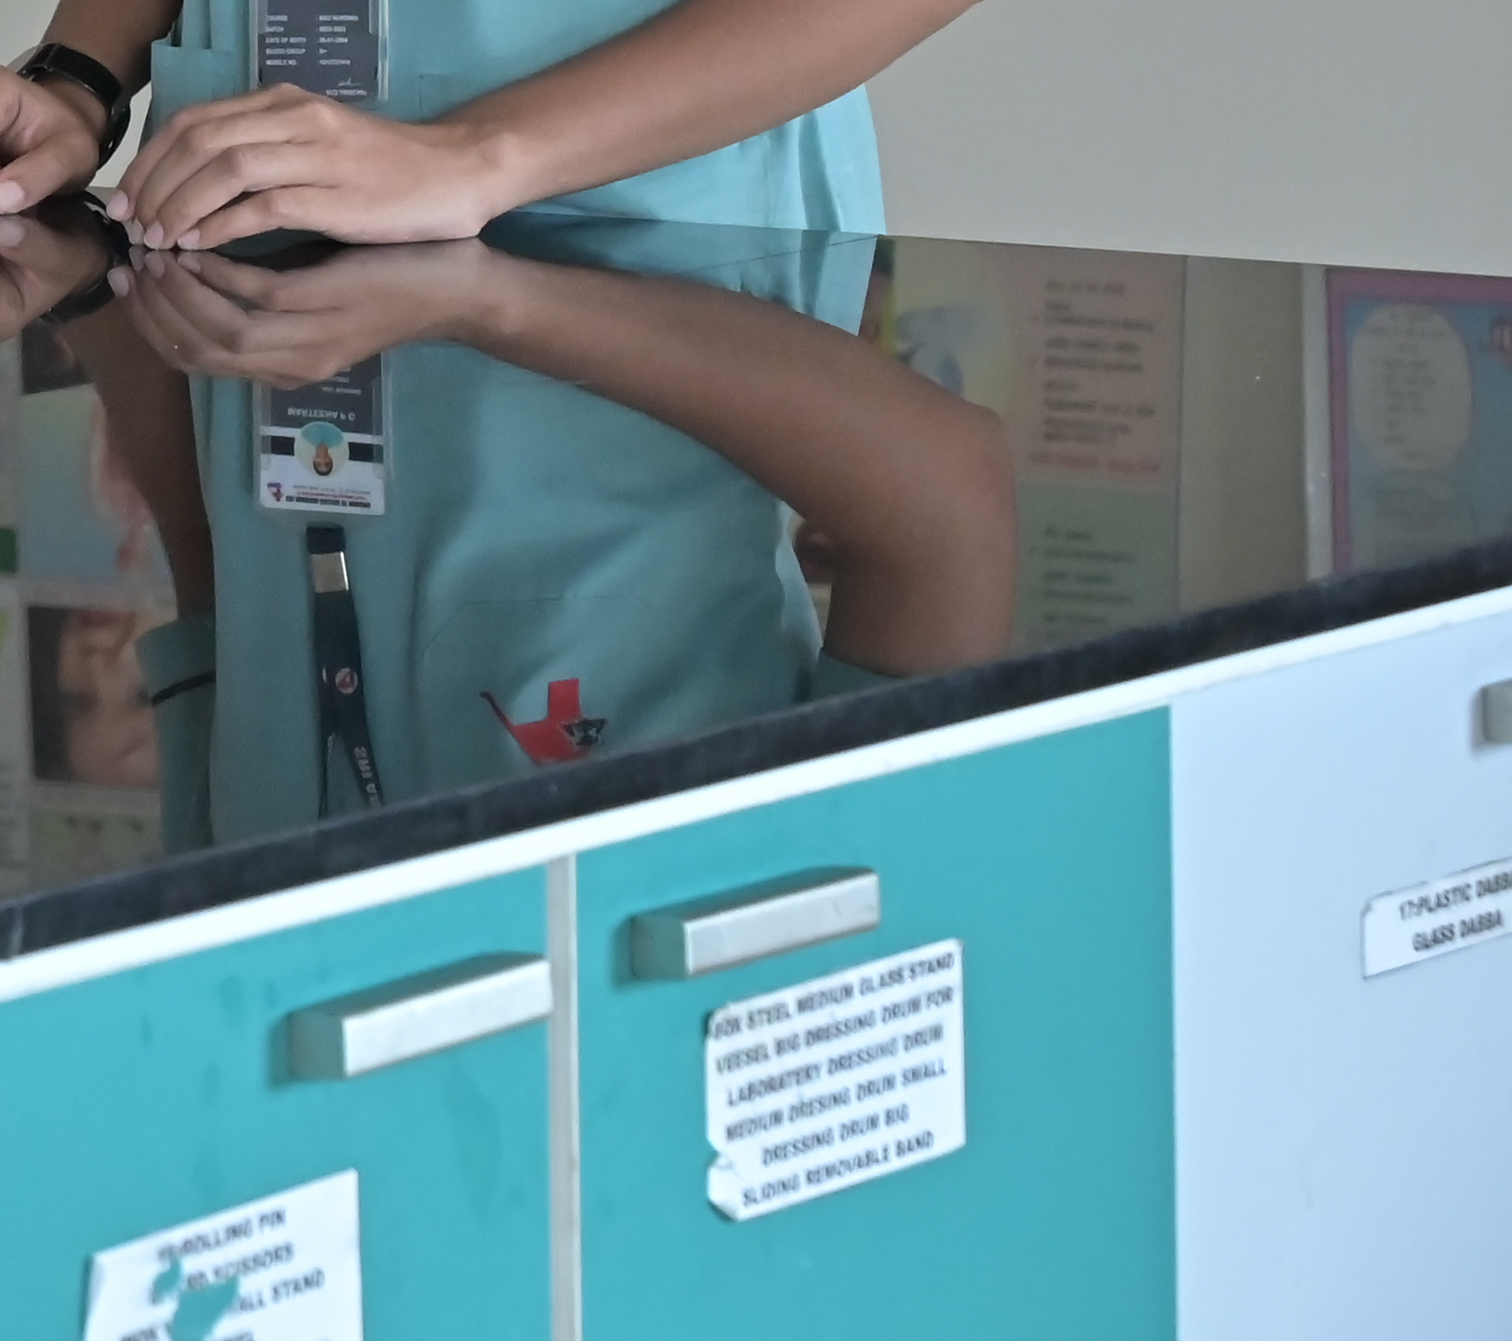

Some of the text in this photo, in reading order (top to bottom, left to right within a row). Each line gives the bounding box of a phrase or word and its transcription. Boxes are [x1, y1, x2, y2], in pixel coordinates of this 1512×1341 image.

[1412, 922, 1456, 953] GLASS
[746, 1002, 791, 1030] STEEL
[796, 982, 855, 1014] MEDIUM
[858, 966, 906, 996] GLASS
[907, 952, 955, 983] STAND
[775, 1033, 802, 1057] BIG
[804, 1010, 877, 1048] DRESSING
[881, 995, 923, 1024] DRUM
[826, 1037, 899, 1076] DRESSING
[902, 1023, 945, 1052] DRUM
[725, 1108, 785, 1143] MEDIUM
[855, 1073, 897, 1102] DRUM
[900, 1056, 948, 1086] SMALL
[761, 1103, 910, 1167] DRESSING DRUM BIG
[742, 1130, 935, 1207] SLIDING REMOVABLE BAND
[257, 1207, 287, 1234] PIN
[270, 1267, 327, 1303] STAND
